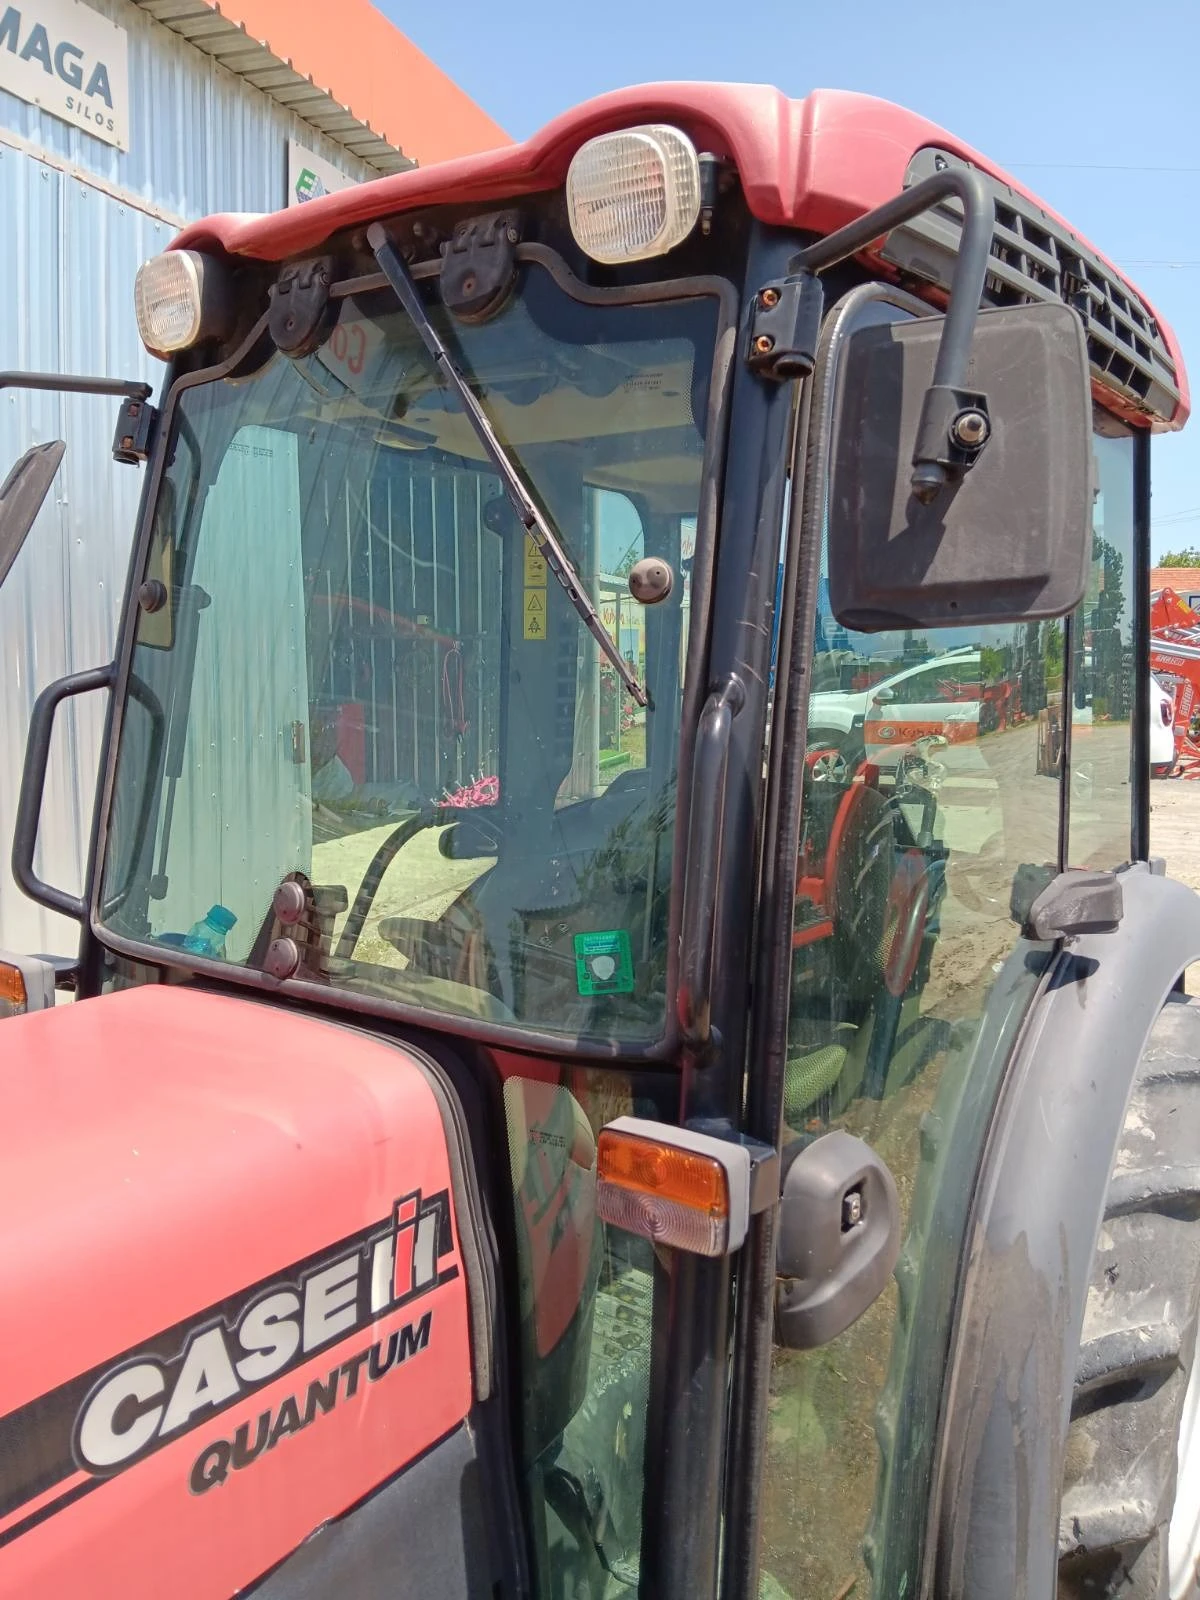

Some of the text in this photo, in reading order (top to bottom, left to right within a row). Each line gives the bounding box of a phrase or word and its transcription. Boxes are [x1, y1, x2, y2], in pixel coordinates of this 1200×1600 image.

[65, 96, 114, 131] SILOS
[79, 1253, 361, 1467] CASE
[189, 1311, 432, 1495] QUANTUM
